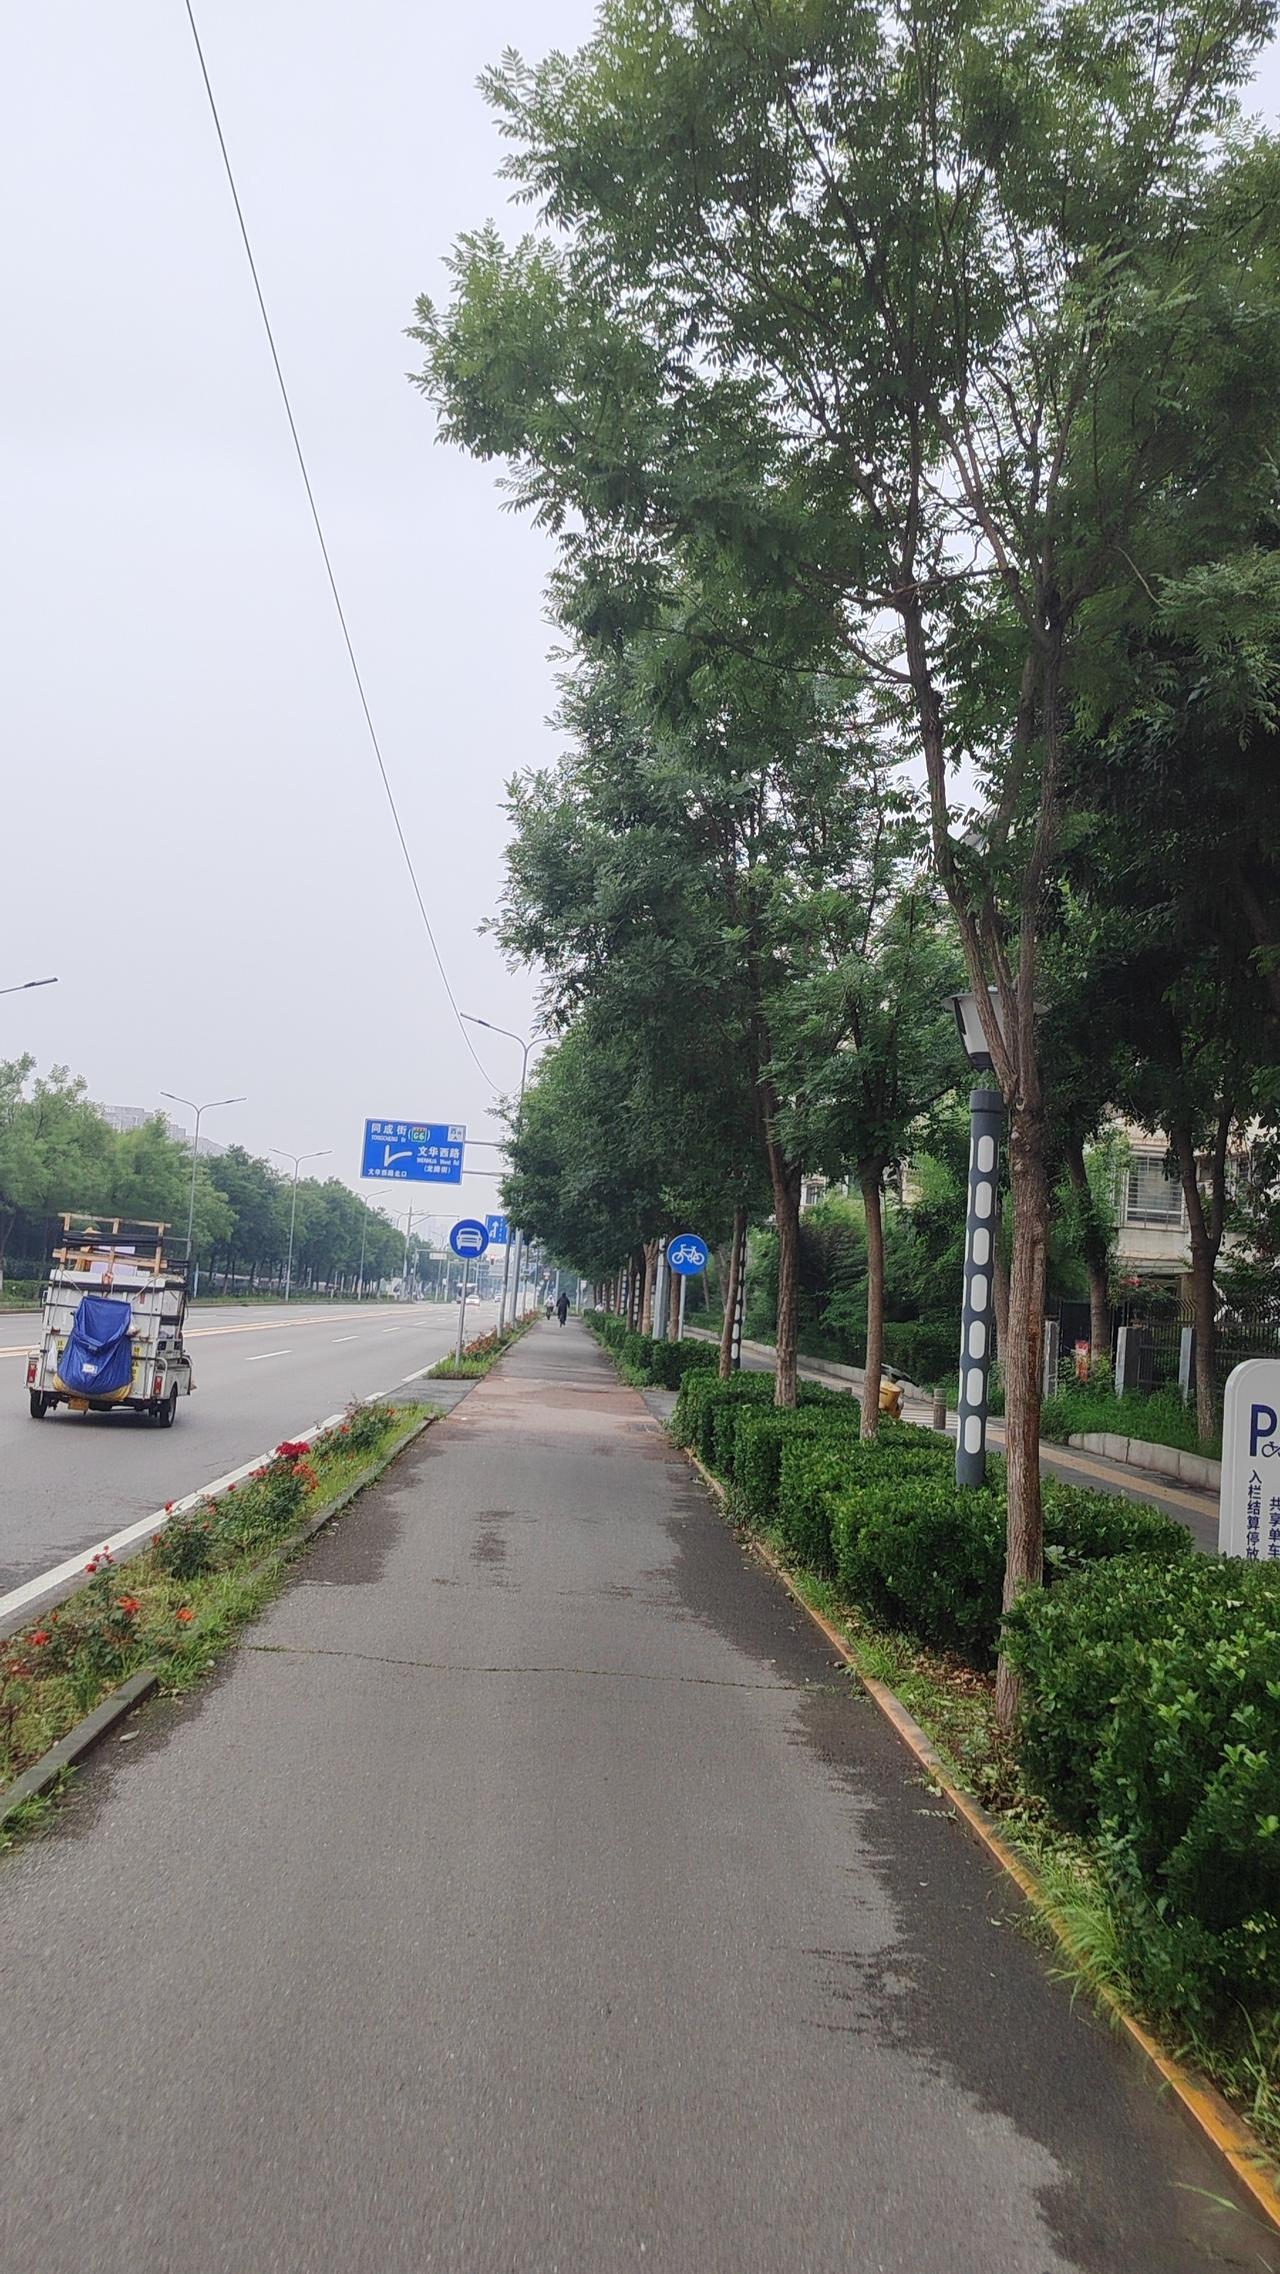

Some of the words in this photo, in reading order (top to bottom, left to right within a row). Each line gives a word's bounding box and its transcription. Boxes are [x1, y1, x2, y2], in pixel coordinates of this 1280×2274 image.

[371, 1123, 407, 1136] 同成街
[417, 1146, 460, 1159] 文华西路
[1249, 1404, 1278, 1457] P
[1246, 1469, 1262, 1561] 入栏结算停放
[1267, 1496, 1280, 1558] 共享单车
